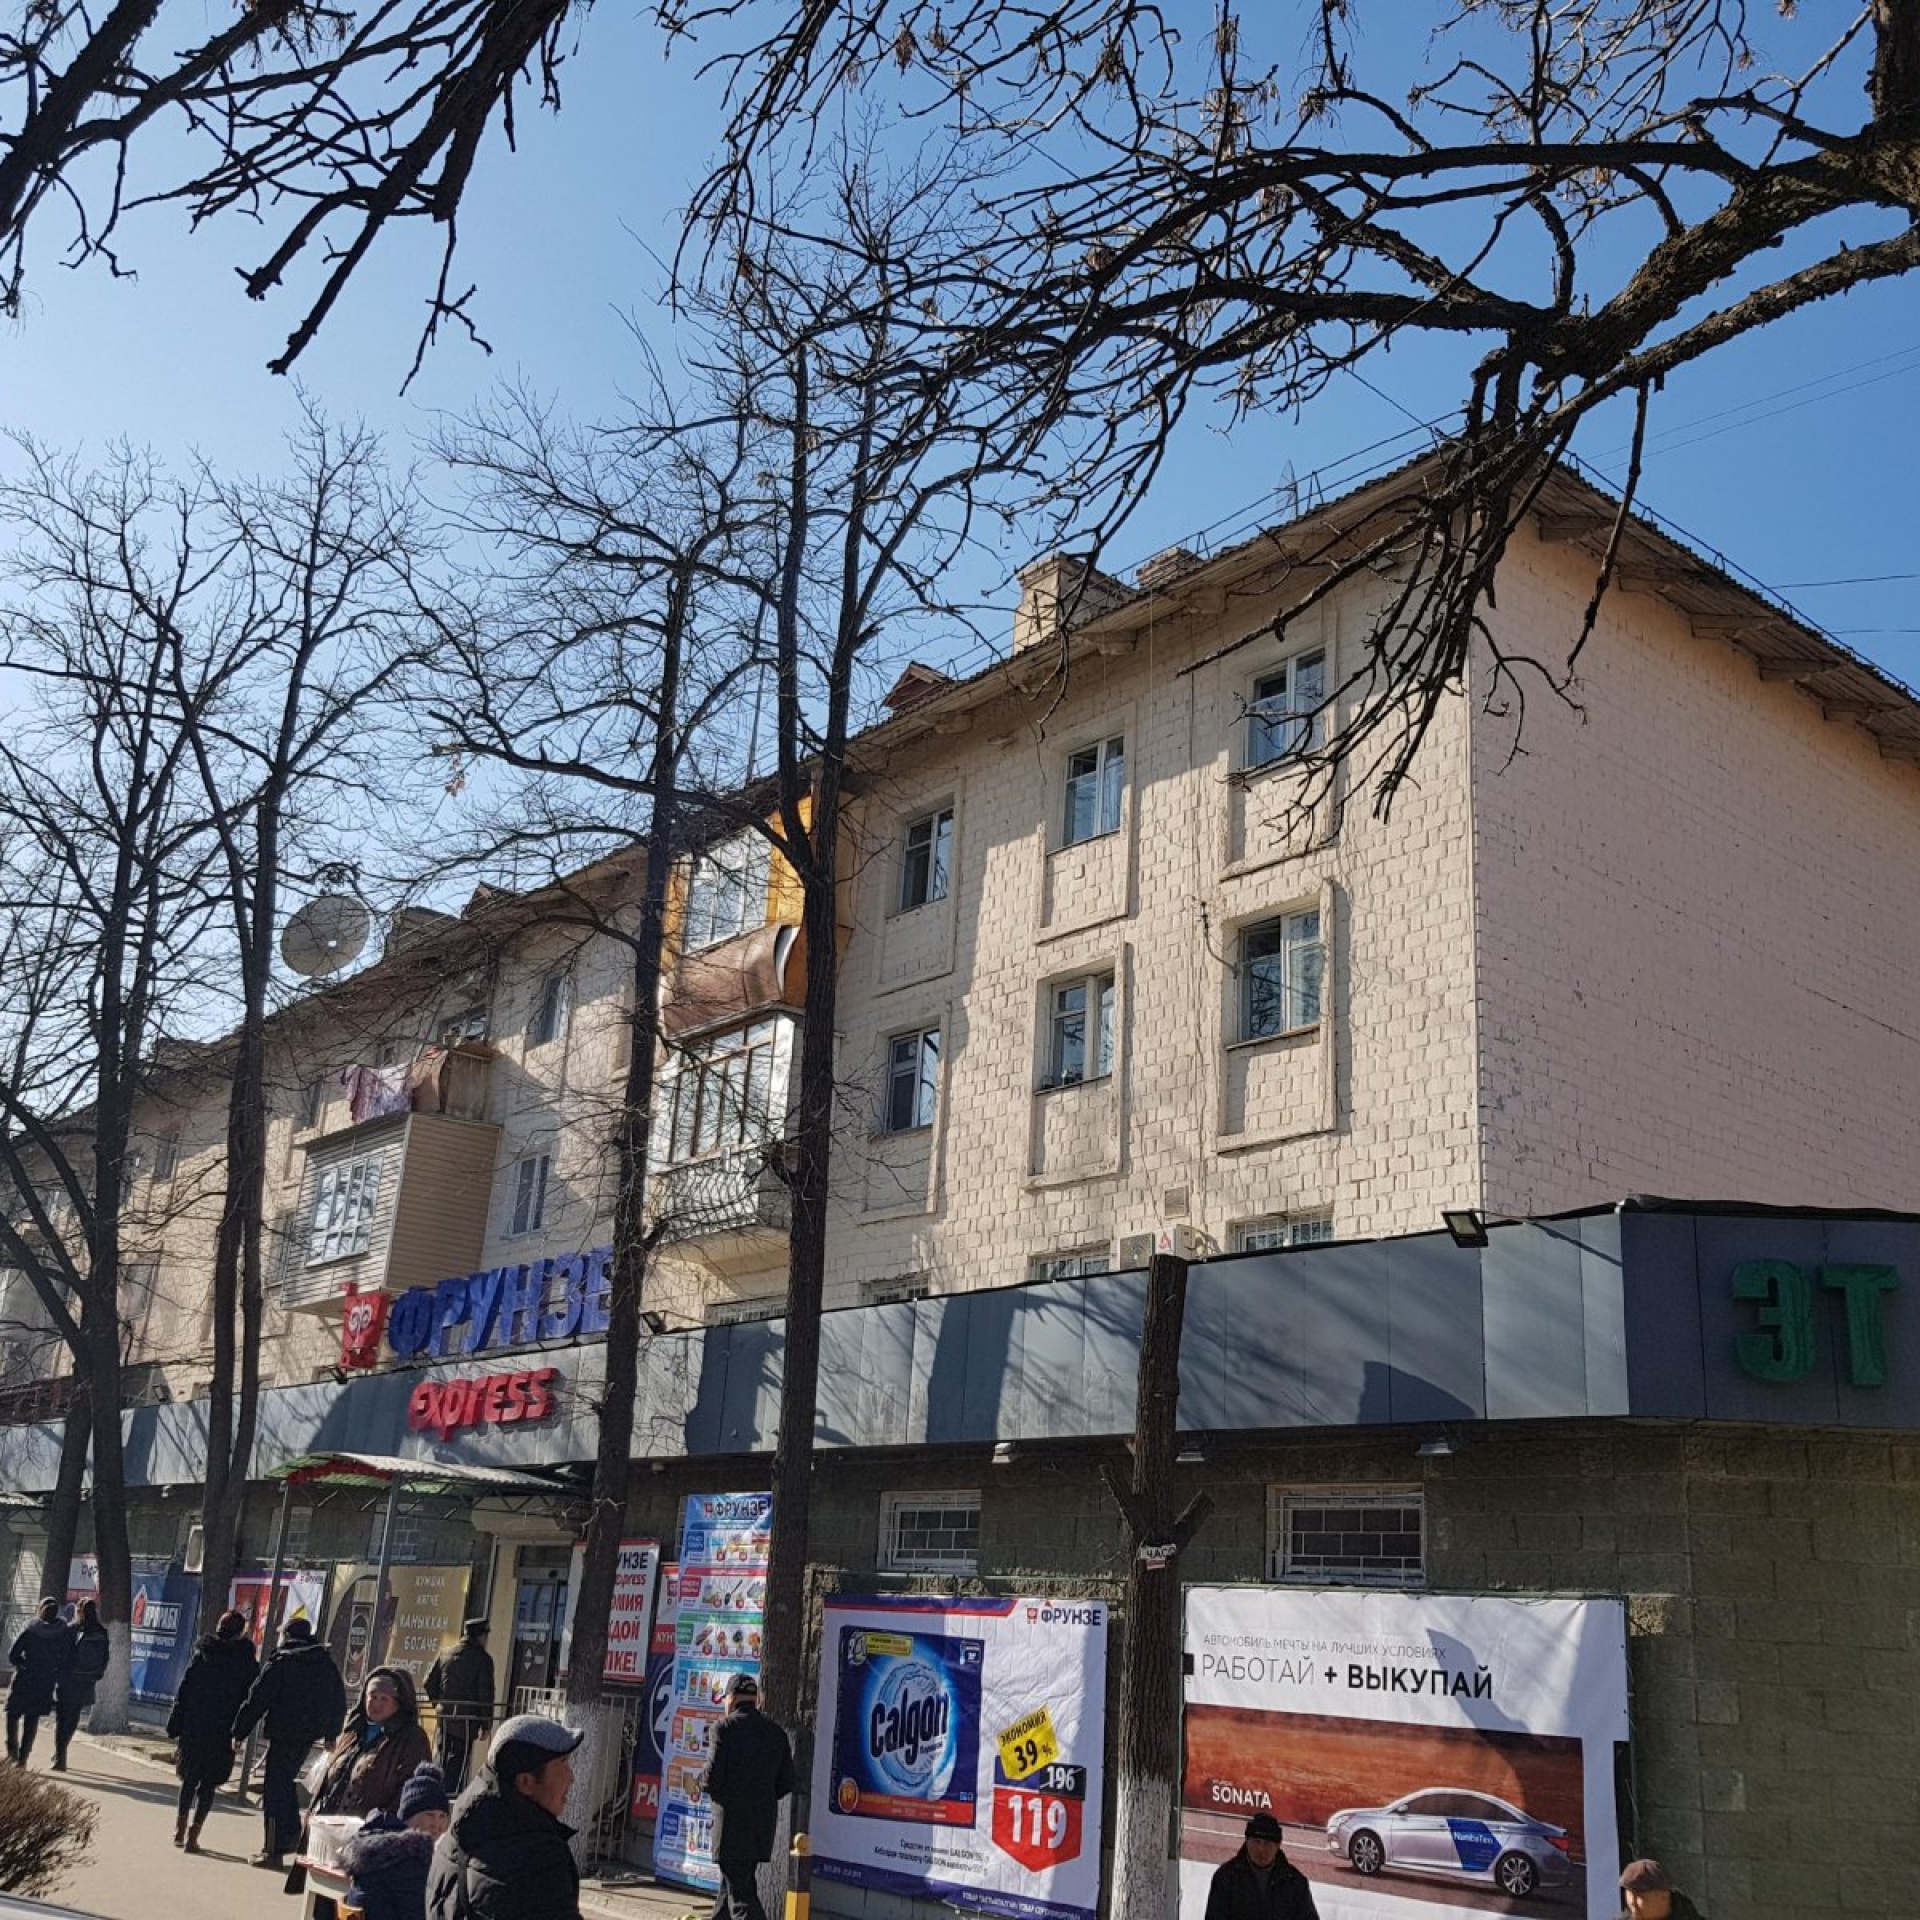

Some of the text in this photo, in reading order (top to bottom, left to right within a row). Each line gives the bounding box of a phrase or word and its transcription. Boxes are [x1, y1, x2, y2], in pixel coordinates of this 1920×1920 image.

[1041, 1607, 1102, 1627] ФРУНЗЕ
[1203, 1634, 1447, 1660] АВТОМОБИЛЬ МЕЧТЫ НА ЛУЧШИХ УСЛОВИЯХ
[1202, 1653, 1314, 1685] РАБОТАЙ
[1348, 1663, 1492, 1700] ВЫКУПАЙ
[871, 1687, 950, 1766] Calgon
[1000, 1711, 1047, 1748] ЭКОНОМИЯ
[1014, 1738, 1039, 1773] 39
[1046, 1766, 1076, 1792] 196
[1212, 1785, 1273, 1808] SONATA
[1008, 1794, 1068, 1849] 119
